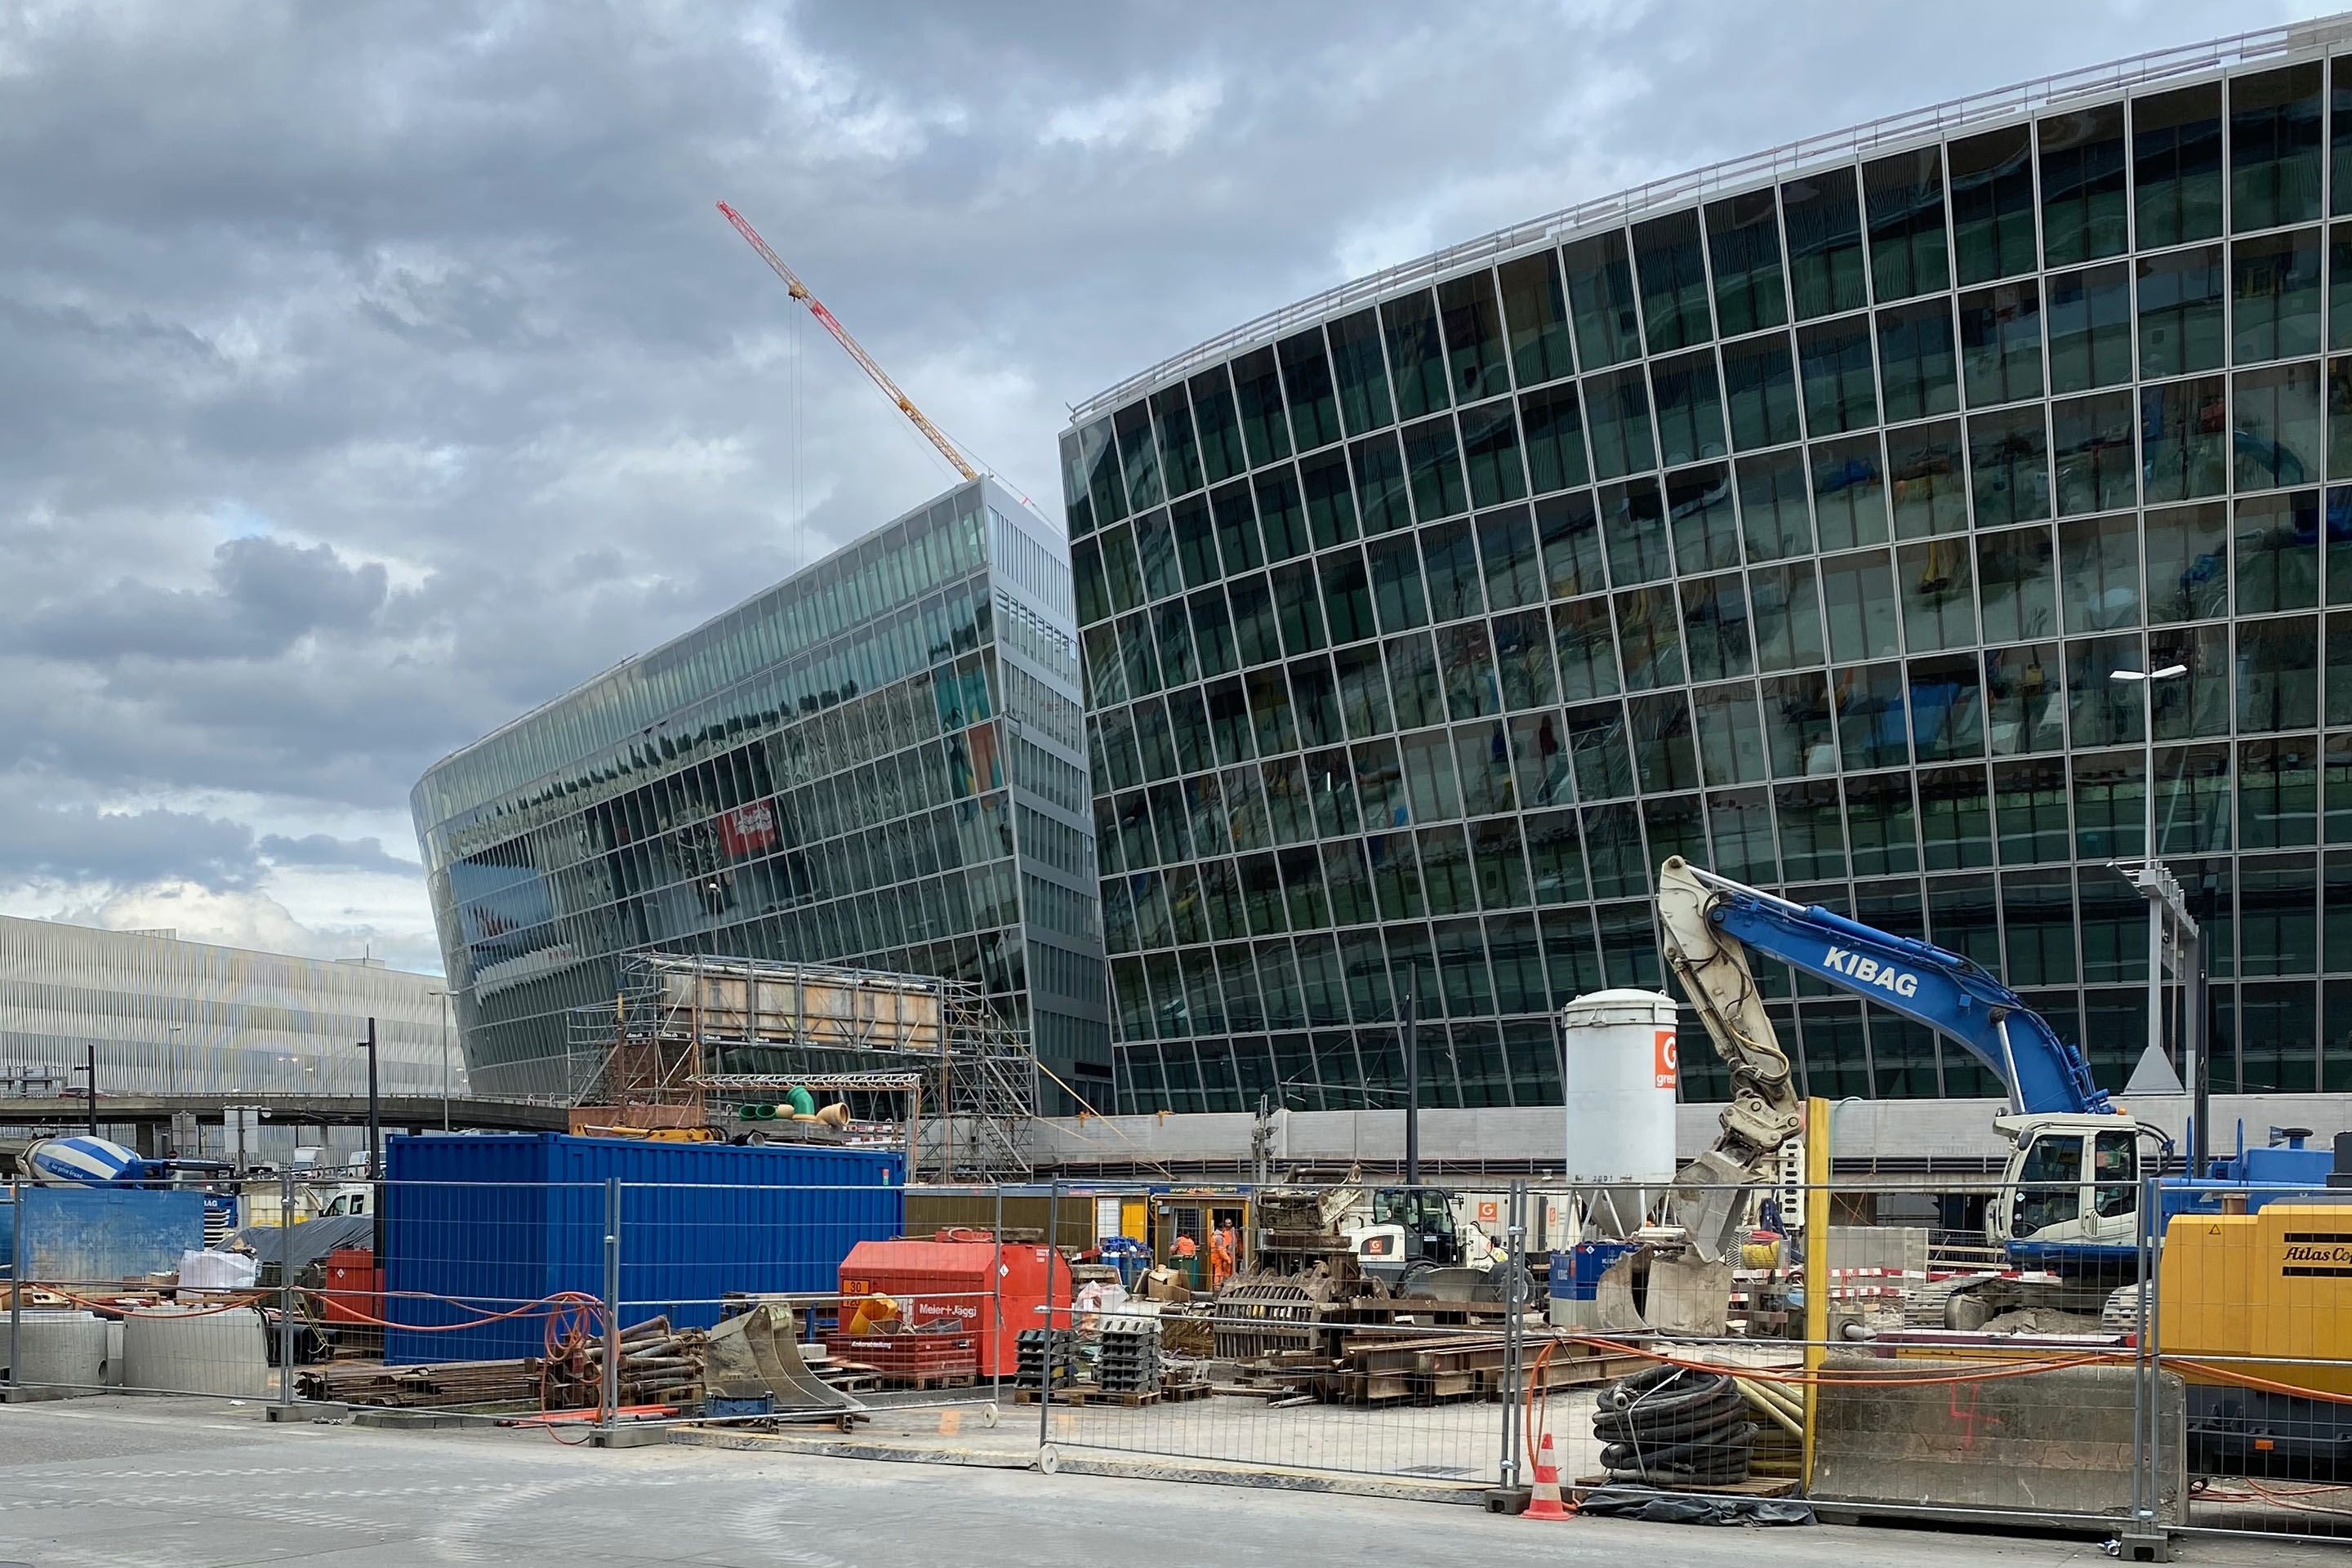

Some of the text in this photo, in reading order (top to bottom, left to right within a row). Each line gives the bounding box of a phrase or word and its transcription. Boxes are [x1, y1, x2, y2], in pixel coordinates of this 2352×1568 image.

[1823, 946, 1918, 998] KIBAG
[1663, 1036, 1677, 1071] G
[1481, 1203, 1494, 1216] G
[1372, 1241, 1380, 1250] G
[2282, 1246, 2331, 1261] Atlas
[850, 1281, 862, 1293] 30
